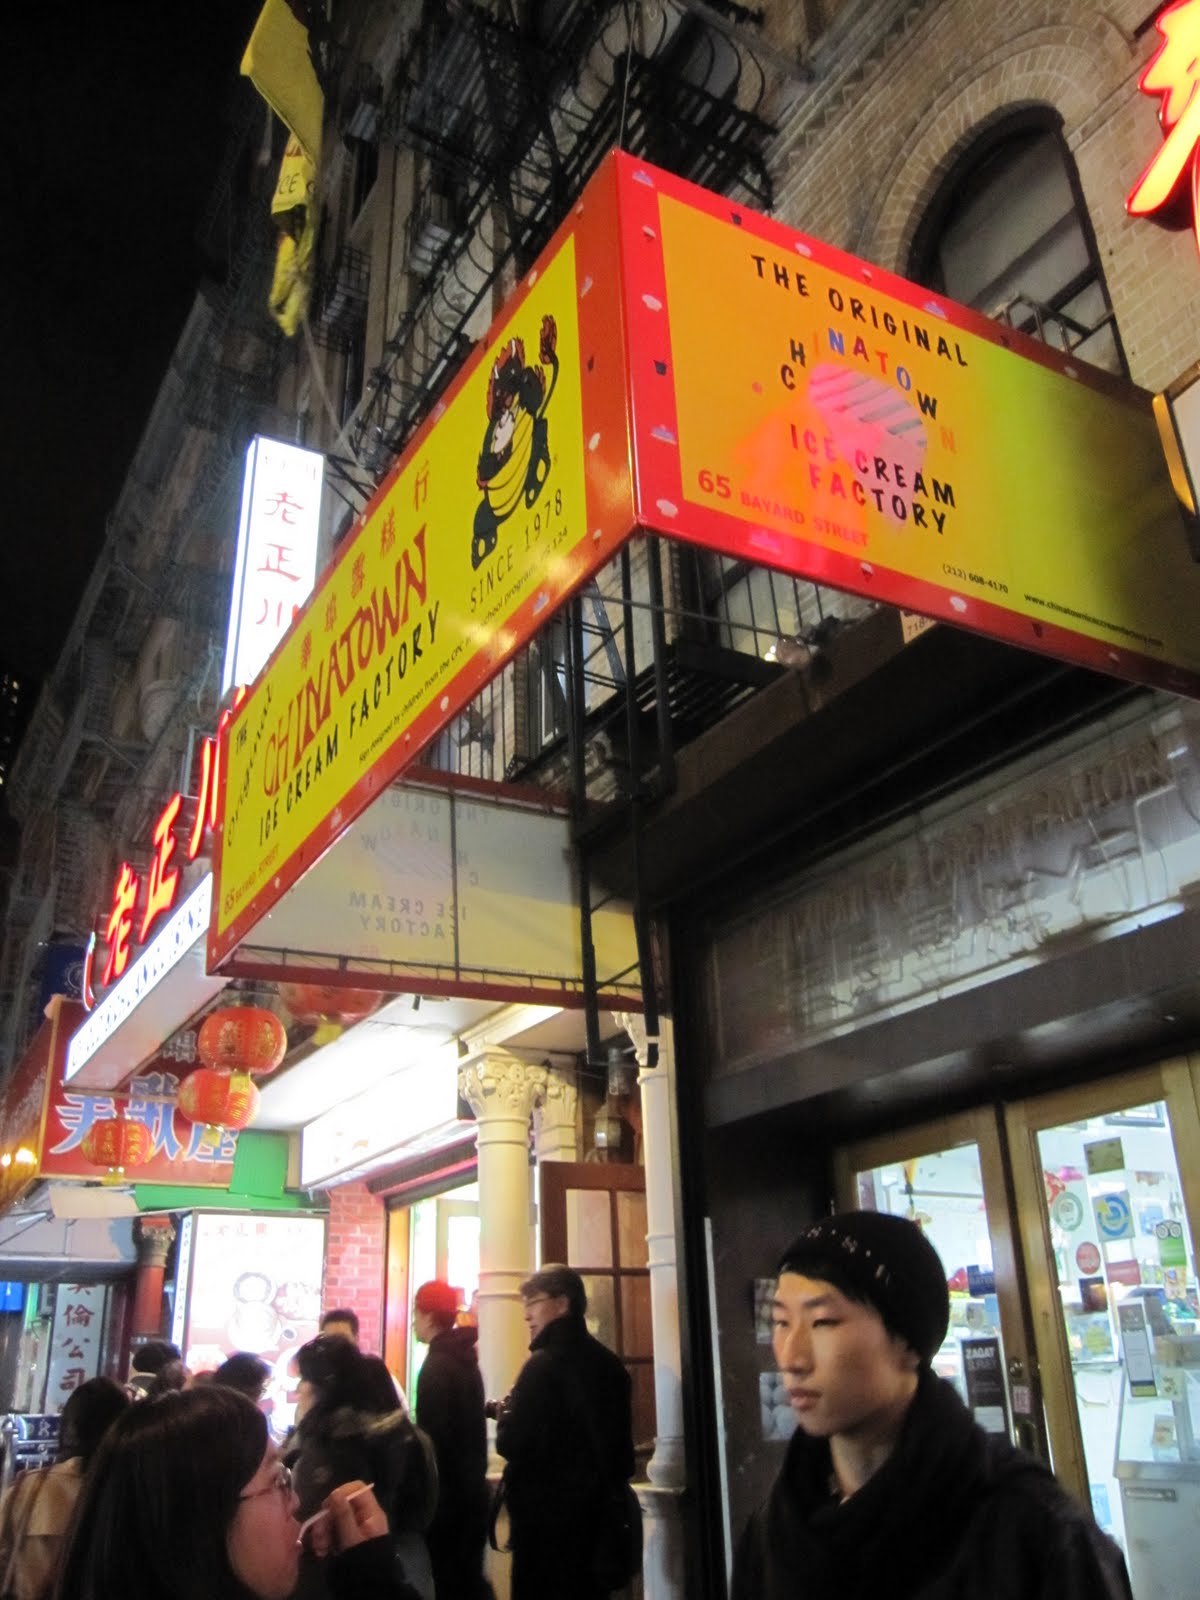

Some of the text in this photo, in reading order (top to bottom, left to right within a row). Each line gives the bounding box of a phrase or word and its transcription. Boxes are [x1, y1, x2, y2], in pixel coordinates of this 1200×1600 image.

[751, 255, 969, 367] THE ORIGINAL
[697, 469, 869, 547] 65 BAYARD STREET
[789, 423, 957, 509] ICE CREAM
[807, 463, 947, 535] FACTORY
[470, 543, 514, 614] SINCE
[524, 488, 563, 552] 1978
[263, 522, 427, 798] CHINATOWN
[259, 600, 440, 846] ICE CREAM FACTORY
[58, 1284, 96, 1414] 倫公司
